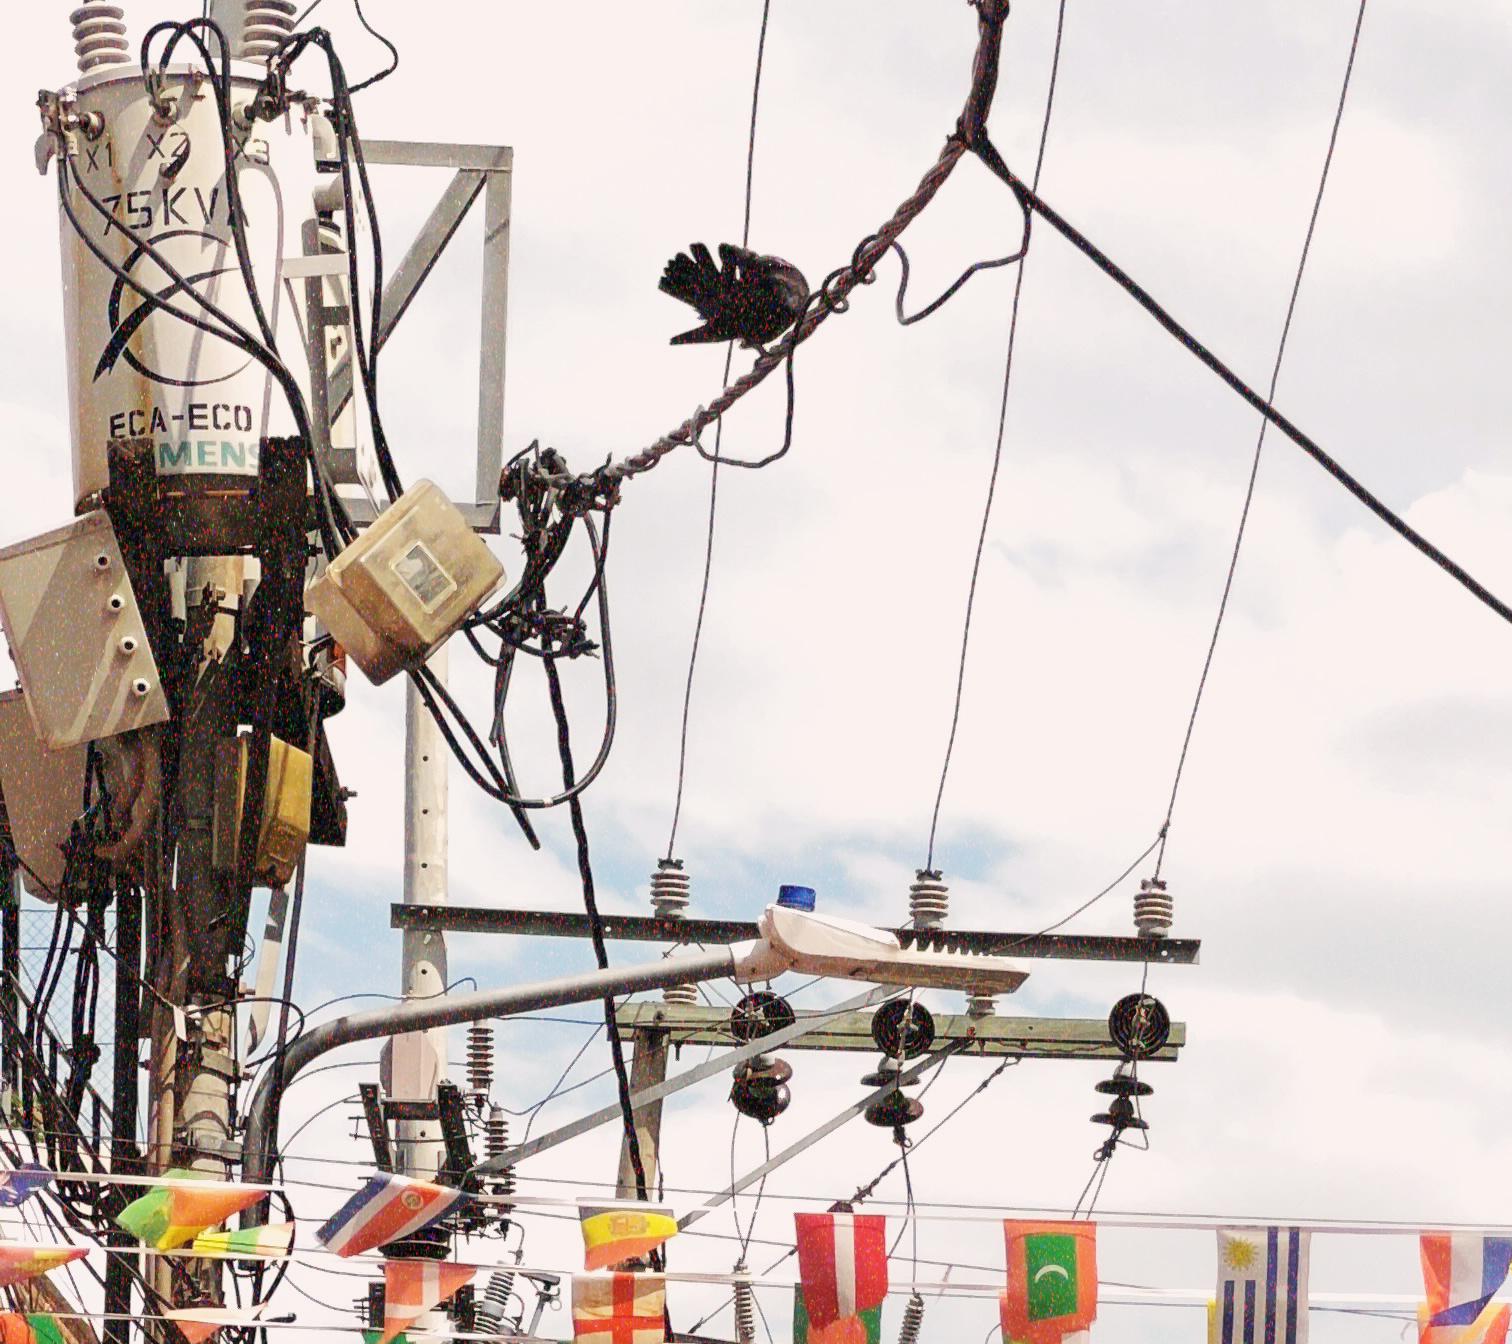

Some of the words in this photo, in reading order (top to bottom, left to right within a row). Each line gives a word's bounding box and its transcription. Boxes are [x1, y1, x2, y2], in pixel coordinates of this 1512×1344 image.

[86, 141, 112, 174] X1
[146, 131, 190, 160] X2
[229, 133, 270, 166] X3
[109, 403, 252, 439] ECA-ECO
